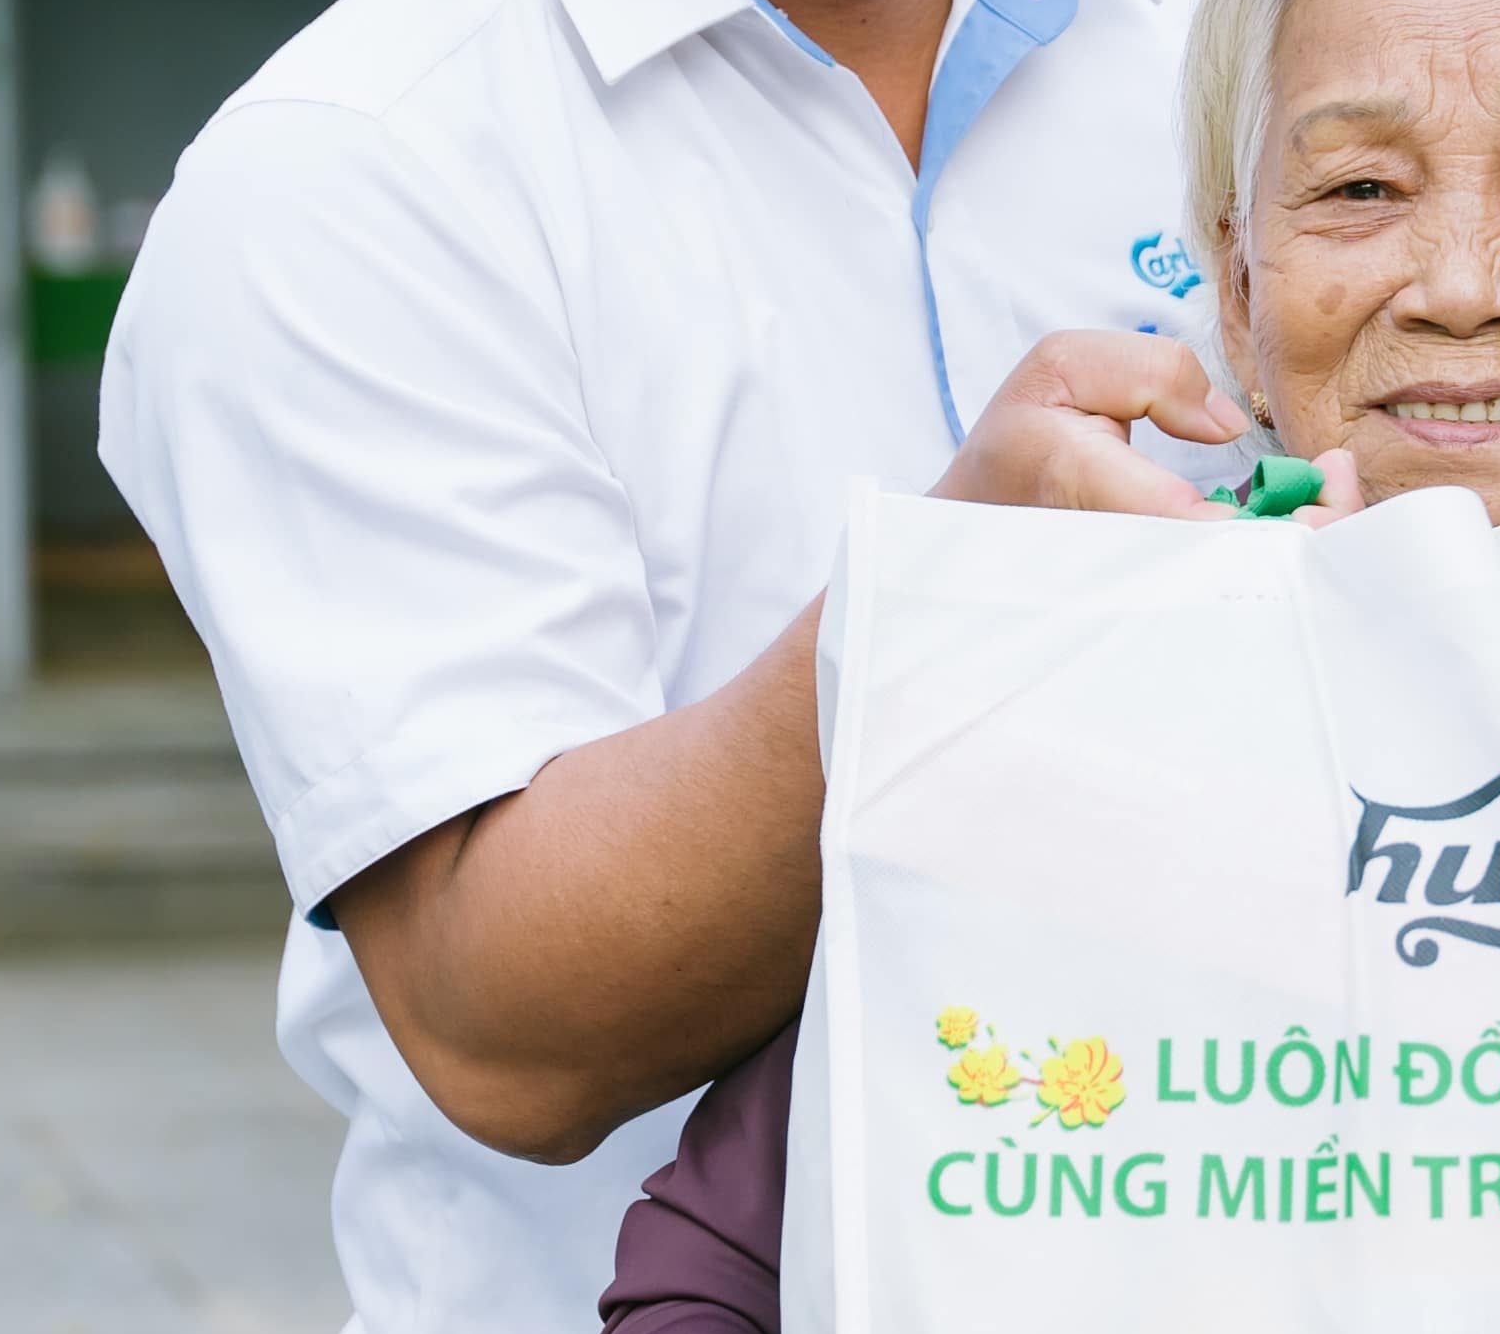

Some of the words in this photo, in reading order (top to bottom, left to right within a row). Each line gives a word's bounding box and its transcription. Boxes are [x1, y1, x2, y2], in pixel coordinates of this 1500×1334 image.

[1130, 230, 1199, 291] Carl
[1156, 1024, 1371, 1108] LUÔN
[926, 1135, 1168, 1217] CÙNG
[1196, 1133, 1391, 1223] MIỀN
